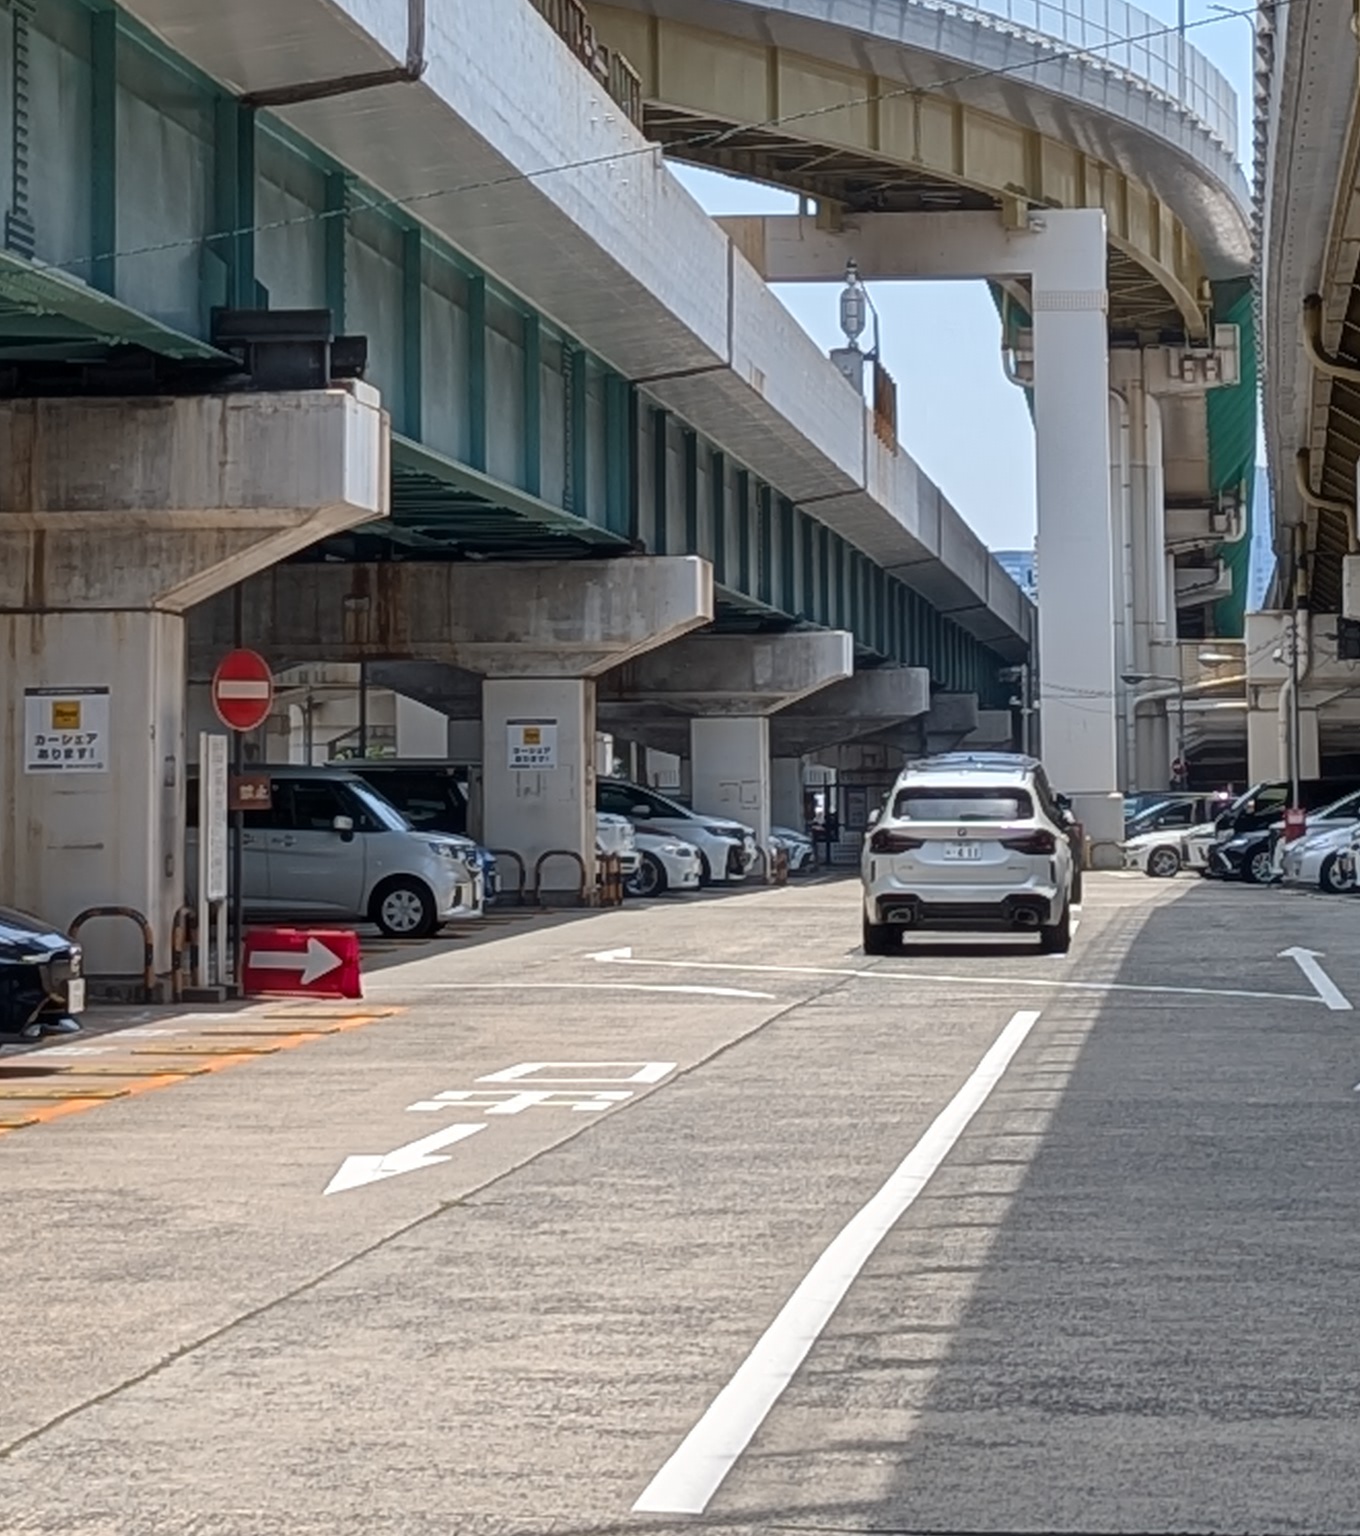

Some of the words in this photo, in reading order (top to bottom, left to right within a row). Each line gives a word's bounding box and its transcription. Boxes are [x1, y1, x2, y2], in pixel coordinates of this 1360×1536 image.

[34, 732, 98, 746] カーシェア
[406, 1061, 678, 1115] 出口
